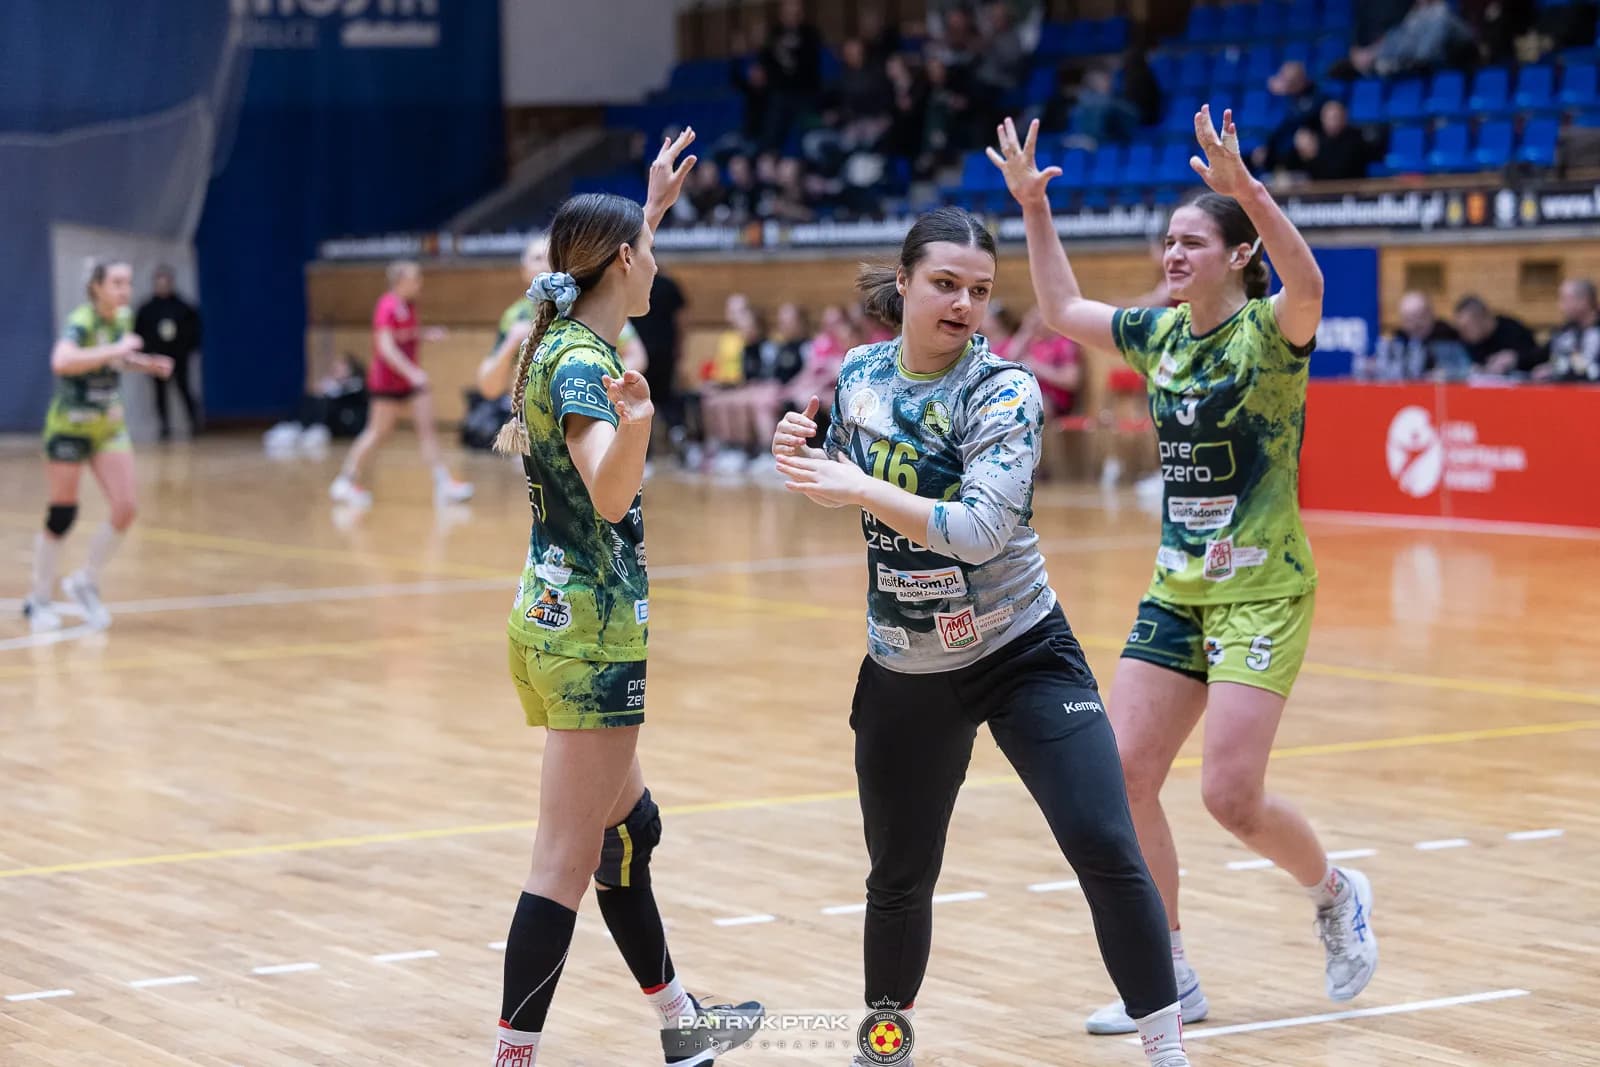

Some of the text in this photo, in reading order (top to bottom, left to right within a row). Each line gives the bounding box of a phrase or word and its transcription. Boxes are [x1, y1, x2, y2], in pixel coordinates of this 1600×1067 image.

[1158, 441, 1192, 462] pre
[868, 440, 918, 495] 16
[1162, 465, 1211, 482] zero
[1246, 635, 1272, 671] 5
[627, 679, 646, 695] pre
[626, 694, 645, 707] zer
